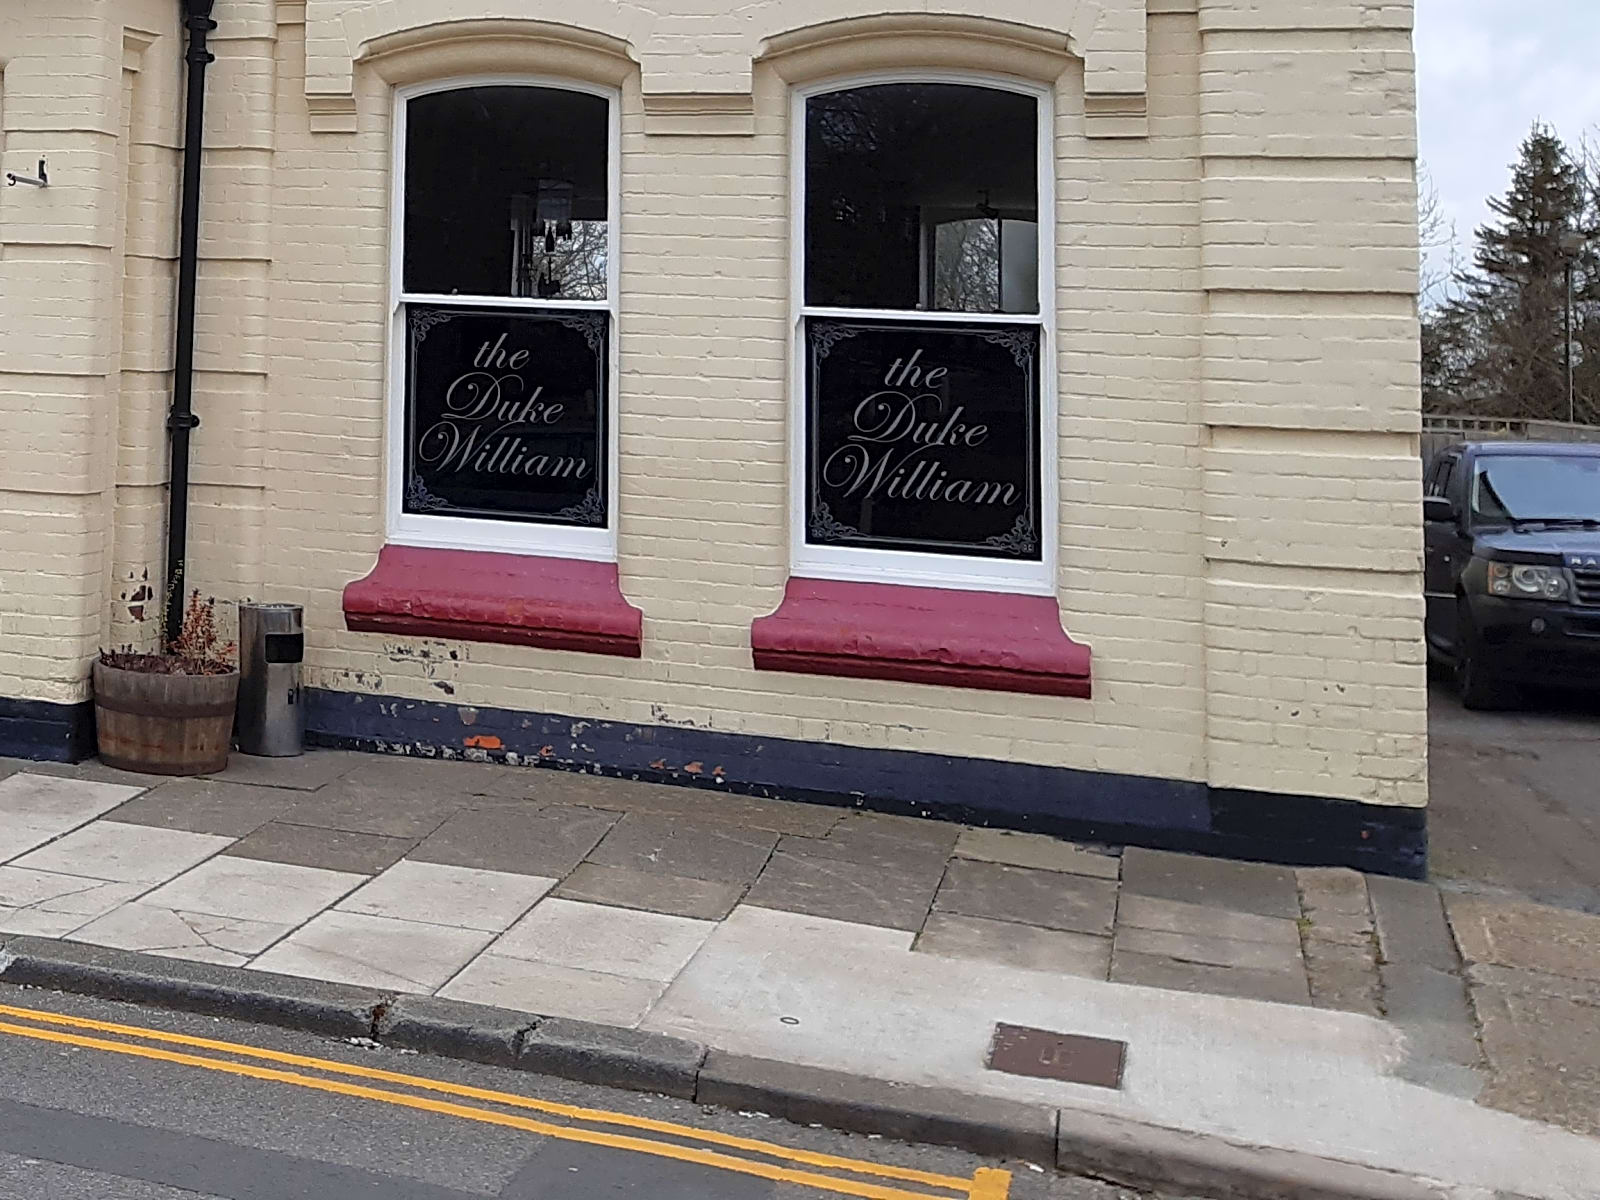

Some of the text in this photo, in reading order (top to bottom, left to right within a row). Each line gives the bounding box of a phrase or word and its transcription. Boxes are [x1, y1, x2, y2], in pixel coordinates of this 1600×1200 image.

[473, 332, 530, 369] the
[884, 349, 948, 388] the
[441, 371, 565, 424] Duke
[847, 391, 989, 446] Duke
[419, 420, 593, 479] William
[823, 442, 1022, 505] William
